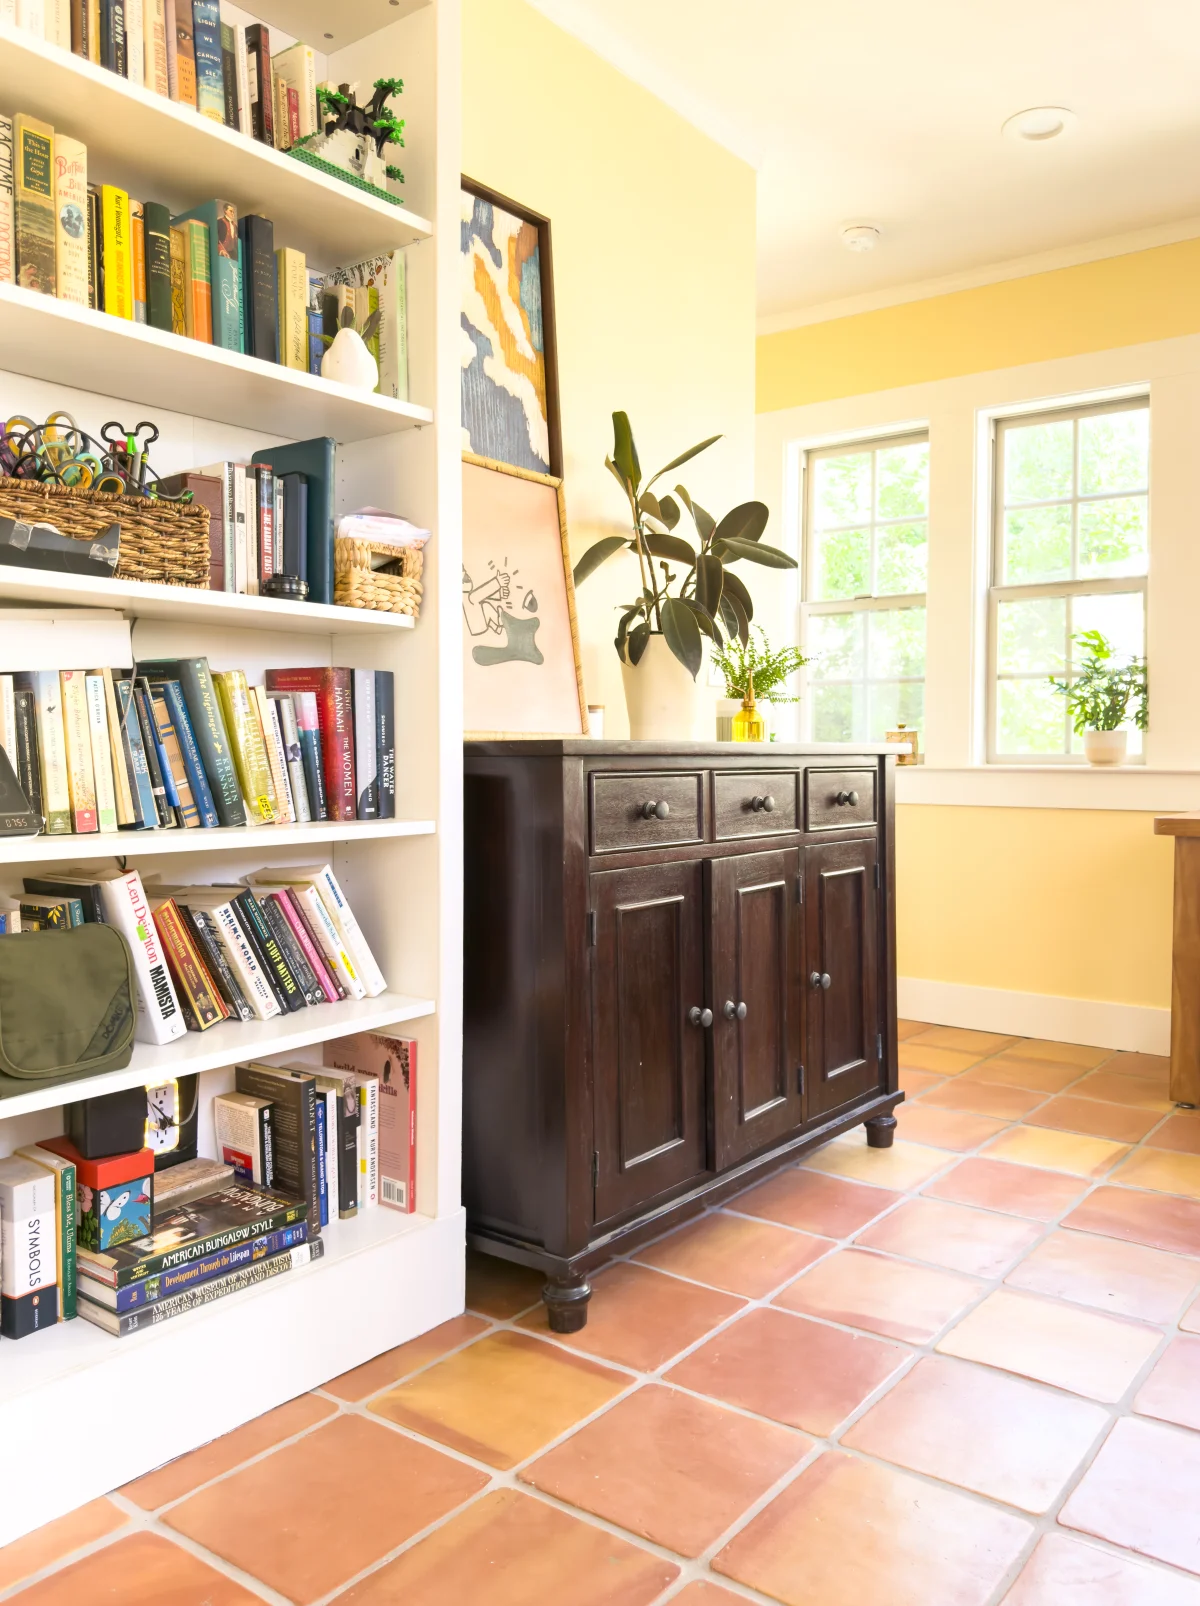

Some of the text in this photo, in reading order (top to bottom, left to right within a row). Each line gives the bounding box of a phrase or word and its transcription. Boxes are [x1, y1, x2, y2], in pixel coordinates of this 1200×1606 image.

[193, 0, 218, 13] ALL THE
[197, 18, 216, 28] LIGHT
[115, 5, 124, 44] GUNN
[197, 51, 220, 63] CANNOT
[25, 145, 49, 159] the Hour
[27, 138, 40, 149] This
[30, 166, 44, 177] Goya
[115, 194, 123, 209] Kurt
[264, 555, 272, 574] COAST
[197, 672, 219, 739] The Nightingale
[334, 687, 344, 733] HANNAH
[73, 708, 81, 738] Behavior
[215, 758, 231, 806] HANNAH
[222, 757, 238, 802] KRISTIN
[343, 751, 353, 797] WOMEN
[260, 797, 273, 820] USED
[125, 877, 176, 1020] Len Deighton MAMISTA
[240, 943, 256, 972] WORLD
[266, 940, 281, 964] STUFF
[275, 960, 296, 995] MATTERS
[256, 975, 268, 999] JONATHAN
[333, 1062, 356, 1073] build
[28, 1218, 41, 1287] SYMBOLS
[162, 1218, 274, 1268] AMERICAN BUNGALOW STYLE
[165, 1249, 250, 1288] Development Through the Lifespan
[152, 1292, 196, 1314] AMERICAN
[196, 1280, 227, 1300] MUSEUM
[228, 1274, 239, 1286] OF
[239, 1261, 272, 1281] NATURAL
[192, 1296, 203, 1308] OF
[203, 1280, 249, 1303] EXPEDITION
[250, 1272, 265, 1285] AND
